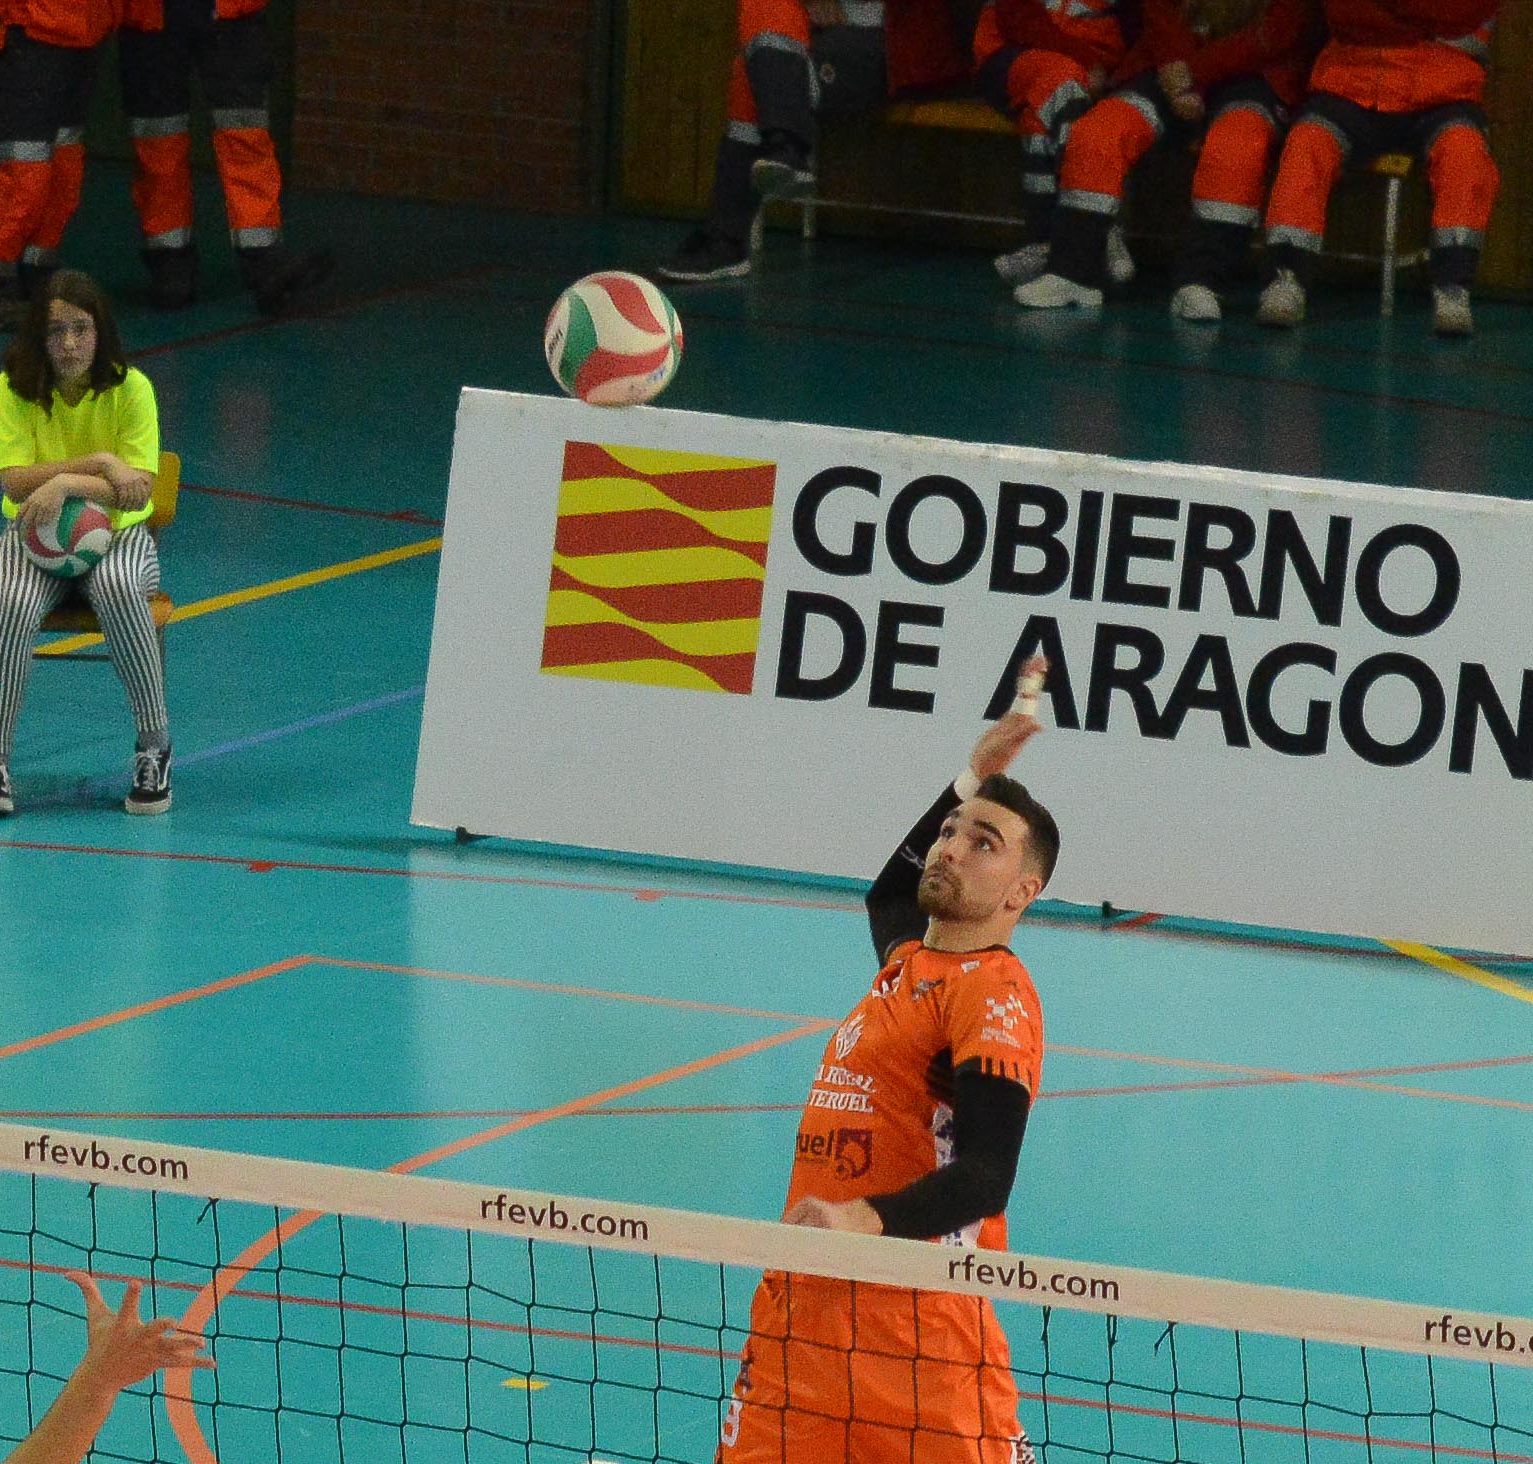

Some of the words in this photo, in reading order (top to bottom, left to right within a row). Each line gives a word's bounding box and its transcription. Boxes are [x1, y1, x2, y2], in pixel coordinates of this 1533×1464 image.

[791, 465, 1461, 637] GOBIERNO
[775, 591, 946, 715] DE
[983, 616, 1533, 780] ARAGON
[22, 1134, 190, 1181] rfevb.com
[796, 1129, 835, 1157] uel
[478, 1194, 650, 1242] rfevb.com
[947, 1255, 1121, 1302] rfevb.com
[1424, 1314, 1533, 1354] rfevb.
